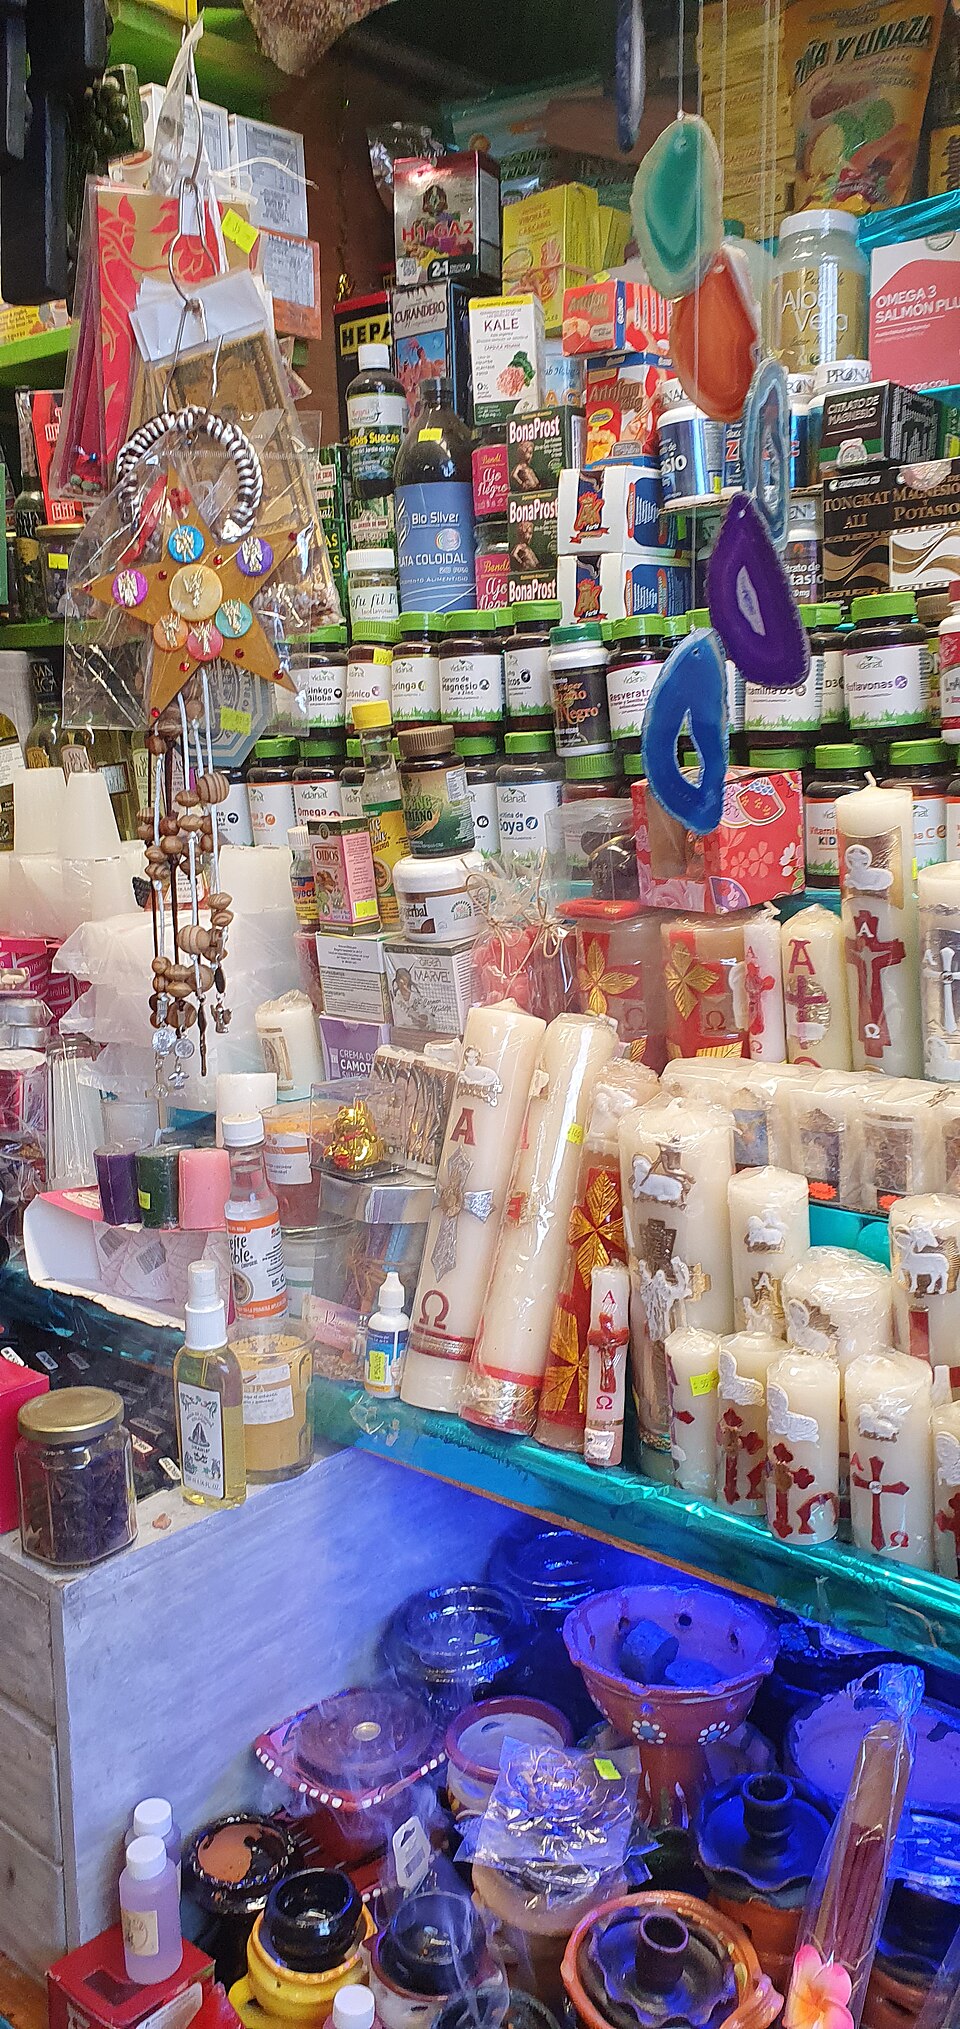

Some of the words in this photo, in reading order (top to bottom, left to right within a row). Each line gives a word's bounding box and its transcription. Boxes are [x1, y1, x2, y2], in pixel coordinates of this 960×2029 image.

[875, 290, 927, 309] OMEGA
[928, 285, 937, 299] 3
[394, 301, 446, 325] CURANDERO
[875, 300, 934, 324] SALMÓN
[936, 296, 960, 312] PLU
[484, 317, 520, 333] KALE
[794, 310, 849, 333] Vea
[827, 398, 866, 415] CITRATO
[866, 395, 880, 407] DE
[828, 407, 877, 425] MAGNESIO
[369, 431, 400, 445] Suecas
[509, 416, 561, 444] BonaProst
[824, 490, 891, 512] TONGKAT
[411, 512, 427, 525] Bio
[430, 511, 459, 524] Silver
[509, 498, 559, 524] BonaProst
[893, 502, 960, 521] POTASIO
[843, 513, 868, 530] ALI
[415, 553, 468, 566] COLOIDAL
[808, 561, 820, 572] de
[508, 578, 557, 603] BonaProst
[350, 593, 367, 609] ofu
[479, 595, 508, 609] Negr
[33, 664, 53, 677] SAN
[609, 688, 651, 700] Resveratr
[558, 703, 599, 725] Negro
[298, 807, 327, 817] Omega
[809, 825, 838, 835] Vitamin
[818, 836, 837, 845] KID
[316, 850, 340, 861] OIDOS
[405, 904, 429, 918] erbal
[857, 922, 874, 938] A
[788, 939, 815, 975] A
[339, 1048, 364, 1060] CREMA
[340, 1060, 372, 1073] CAMOT
[450, 1107, 476, 1146] A
[602, 1290, 615, 1305] A
[419, 1289, 450, 1330] Ω
[595, 1395, 613, 1410] Ω
